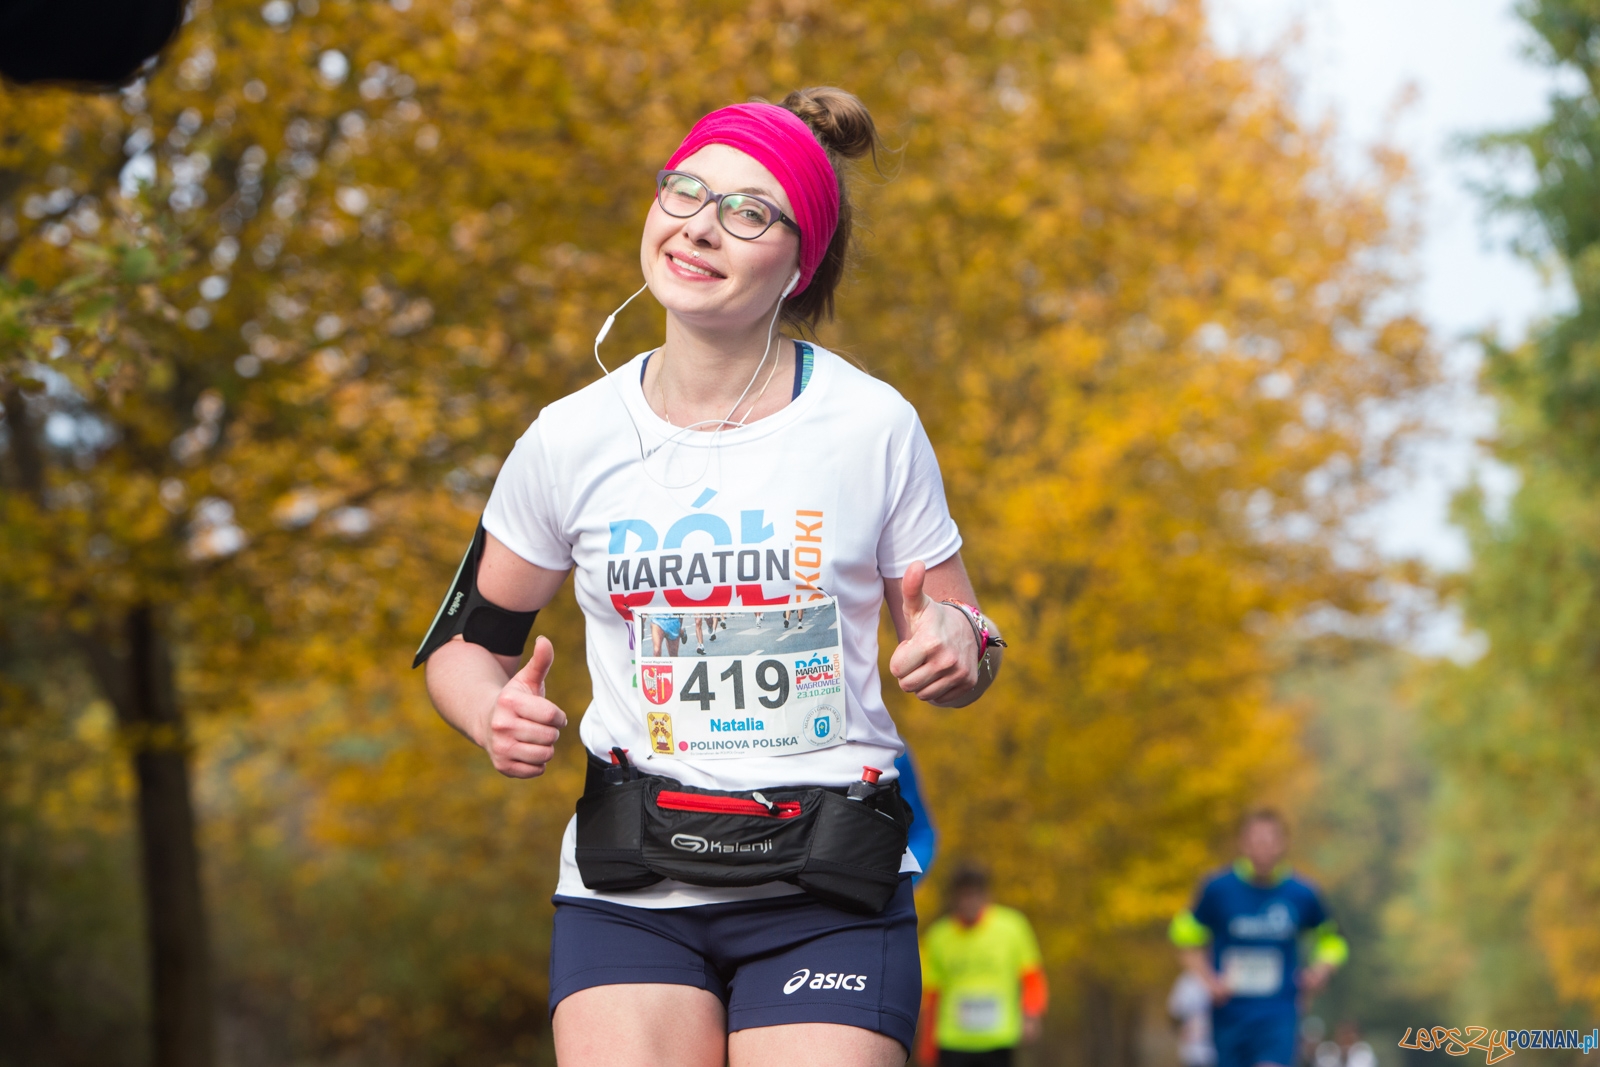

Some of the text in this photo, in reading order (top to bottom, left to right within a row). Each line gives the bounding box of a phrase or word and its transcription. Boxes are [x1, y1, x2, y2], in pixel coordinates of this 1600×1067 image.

[607, 549, 790, 591] MARATON
[447, 591, 464, 616] belkin
[795, 664, 834, 676] MARATON
[679, 659, 790, 711] 419
[796, 686, 841, 699] 23.10.2016
[710, 717, 764, 732] Natalia
[690, 736, 798, 751] POLINOVA POLSKA
[808, 973, 867, 991] asics
